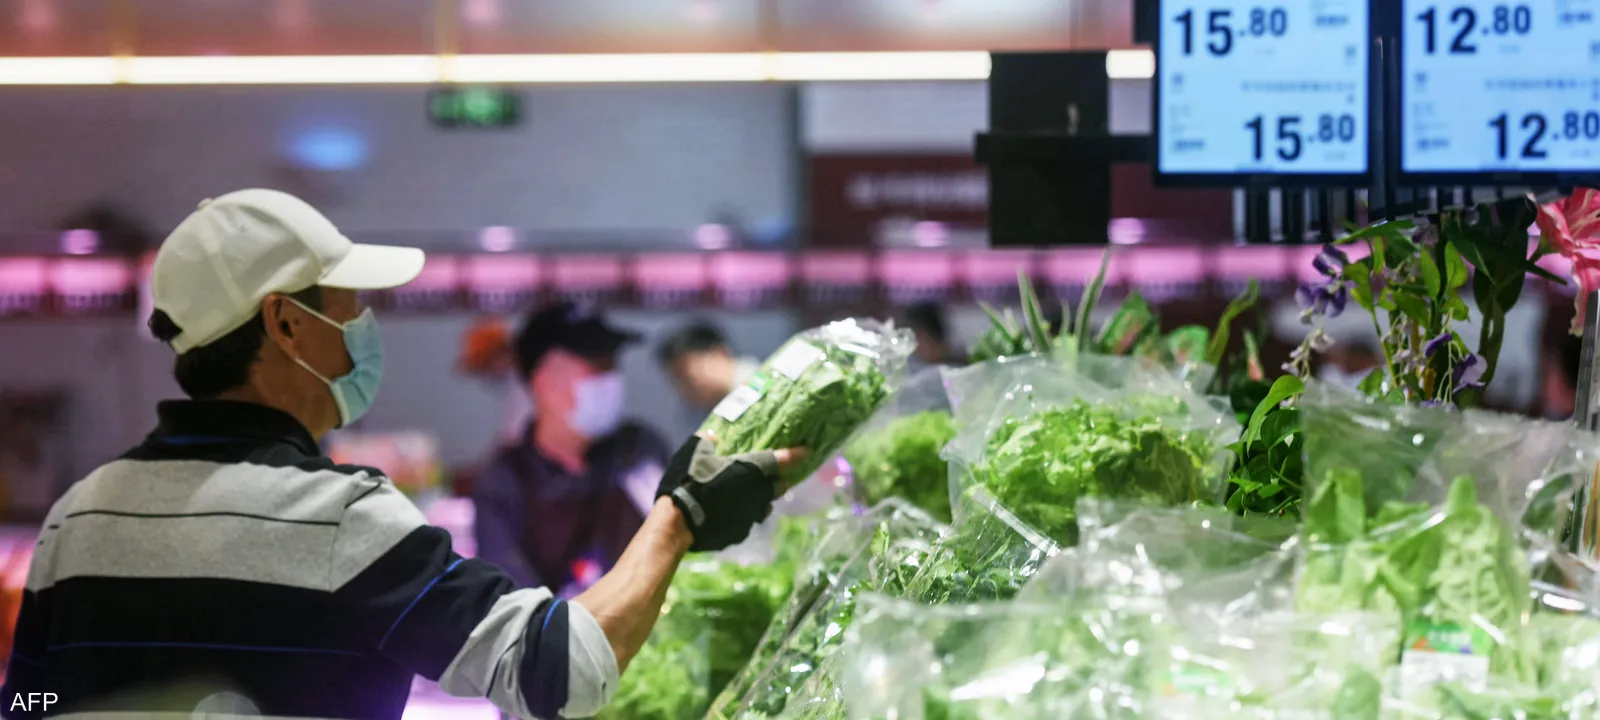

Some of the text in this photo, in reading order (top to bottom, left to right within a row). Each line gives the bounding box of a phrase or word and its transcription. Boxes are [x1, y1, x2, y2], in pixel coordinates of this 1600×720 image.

[1173, 7, 1288, 57] 15.80
[1415, 5, 1531, 55] 12.80
[1244, 113, 1356, 162] 15.80
[1488, 110, 1600, 160] 12.80
